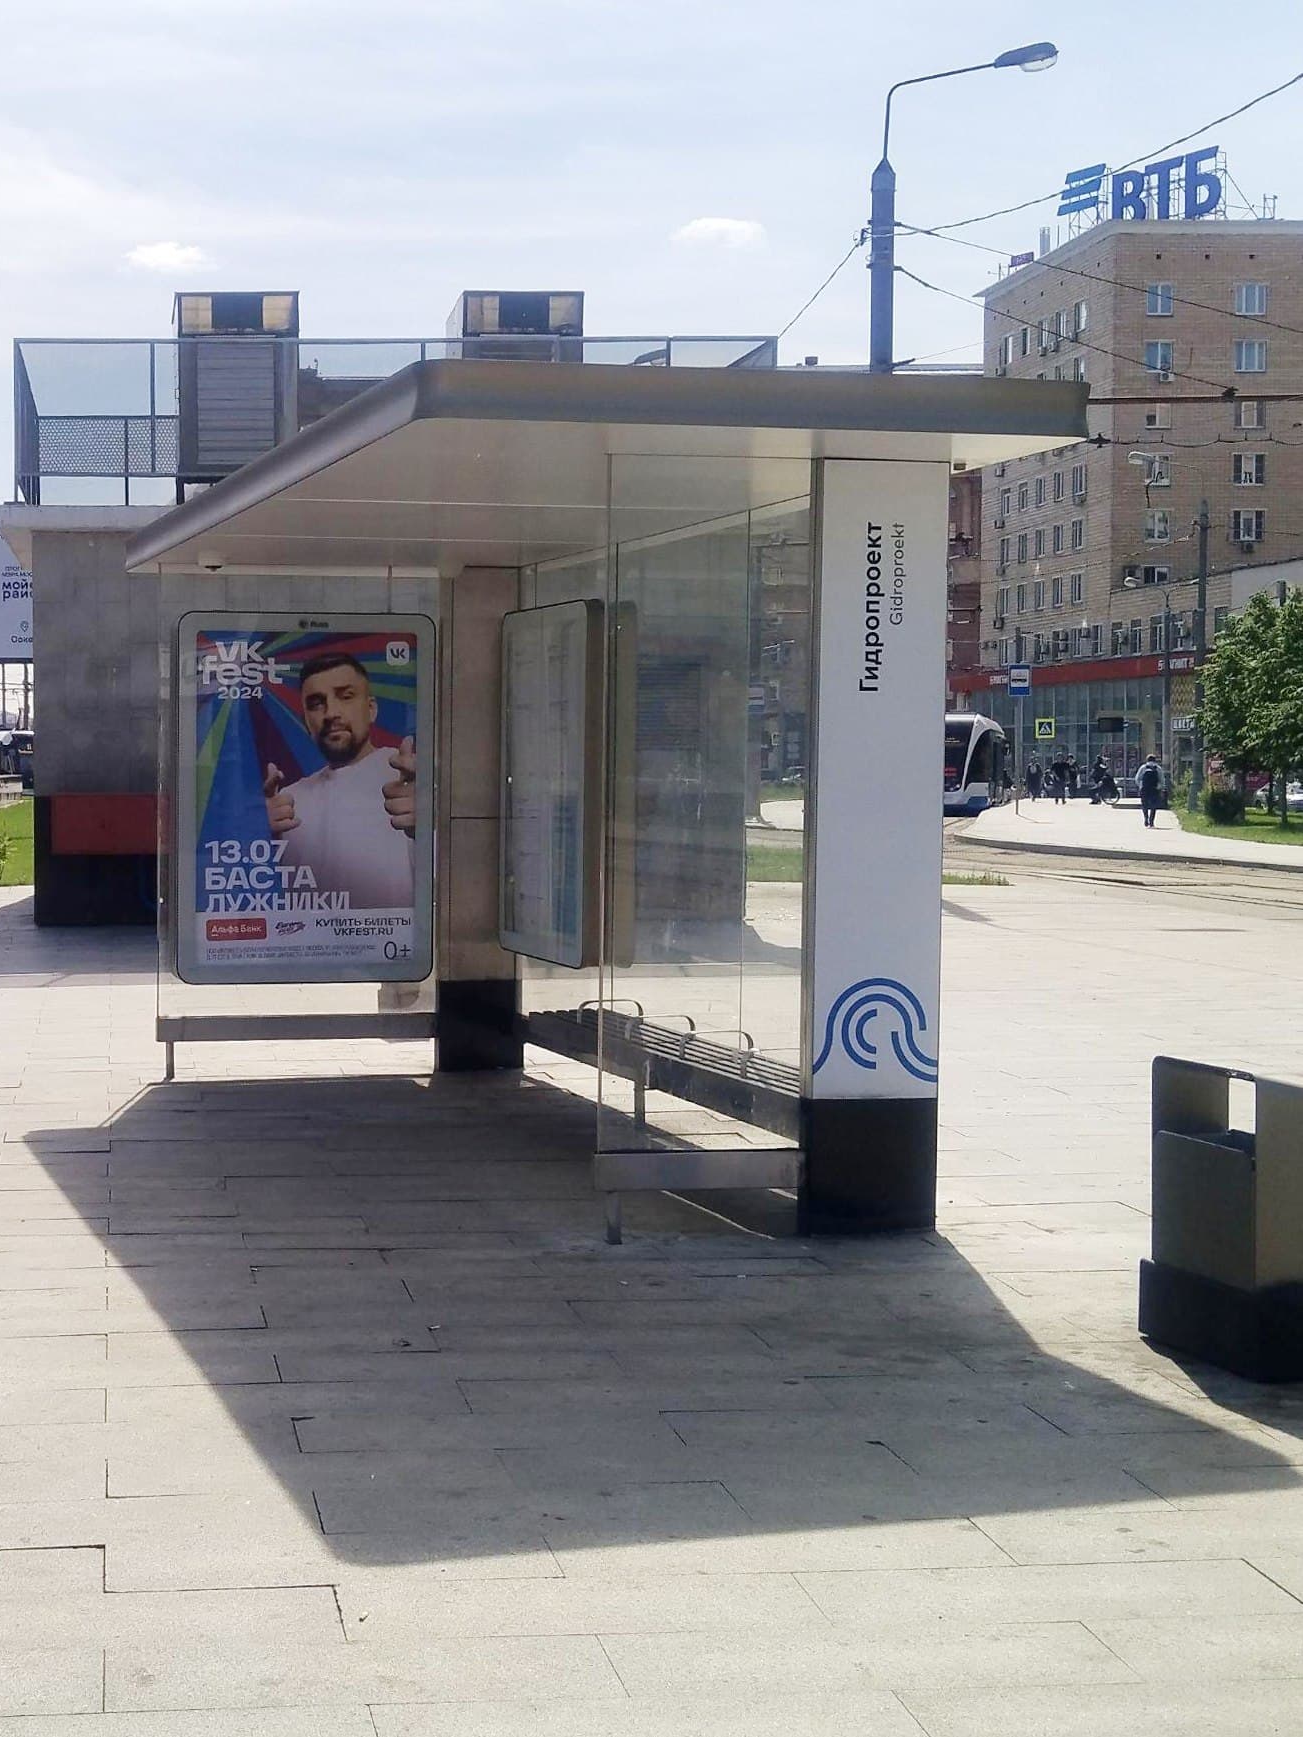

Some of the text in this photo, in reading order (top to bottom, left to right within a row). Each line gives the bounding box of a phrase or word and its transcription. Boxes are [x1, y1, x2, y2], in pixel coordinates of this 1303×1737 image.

[1112, 145, 1222, 220] ВТБ
[889, 522, 906, 625] Gidroproekt
[859, 521, 885, 692] Гидропроект
[216, 641, 265, 662] VK
[198, 655, 290, 685] fest
[217, 686, 263, 699] 2024
[205, 840, 289, 864] 13.07
[205, 865, 317, 890] БАСТА
[206, 891, 350, 912] ЛУЖНИКИ
[315, 917, 411, 927] КУПИТЬ БИЛЕТЫ
[333, 927, 394, 936] VKFEST.RU
[384, 941, 412, 960] 0+
